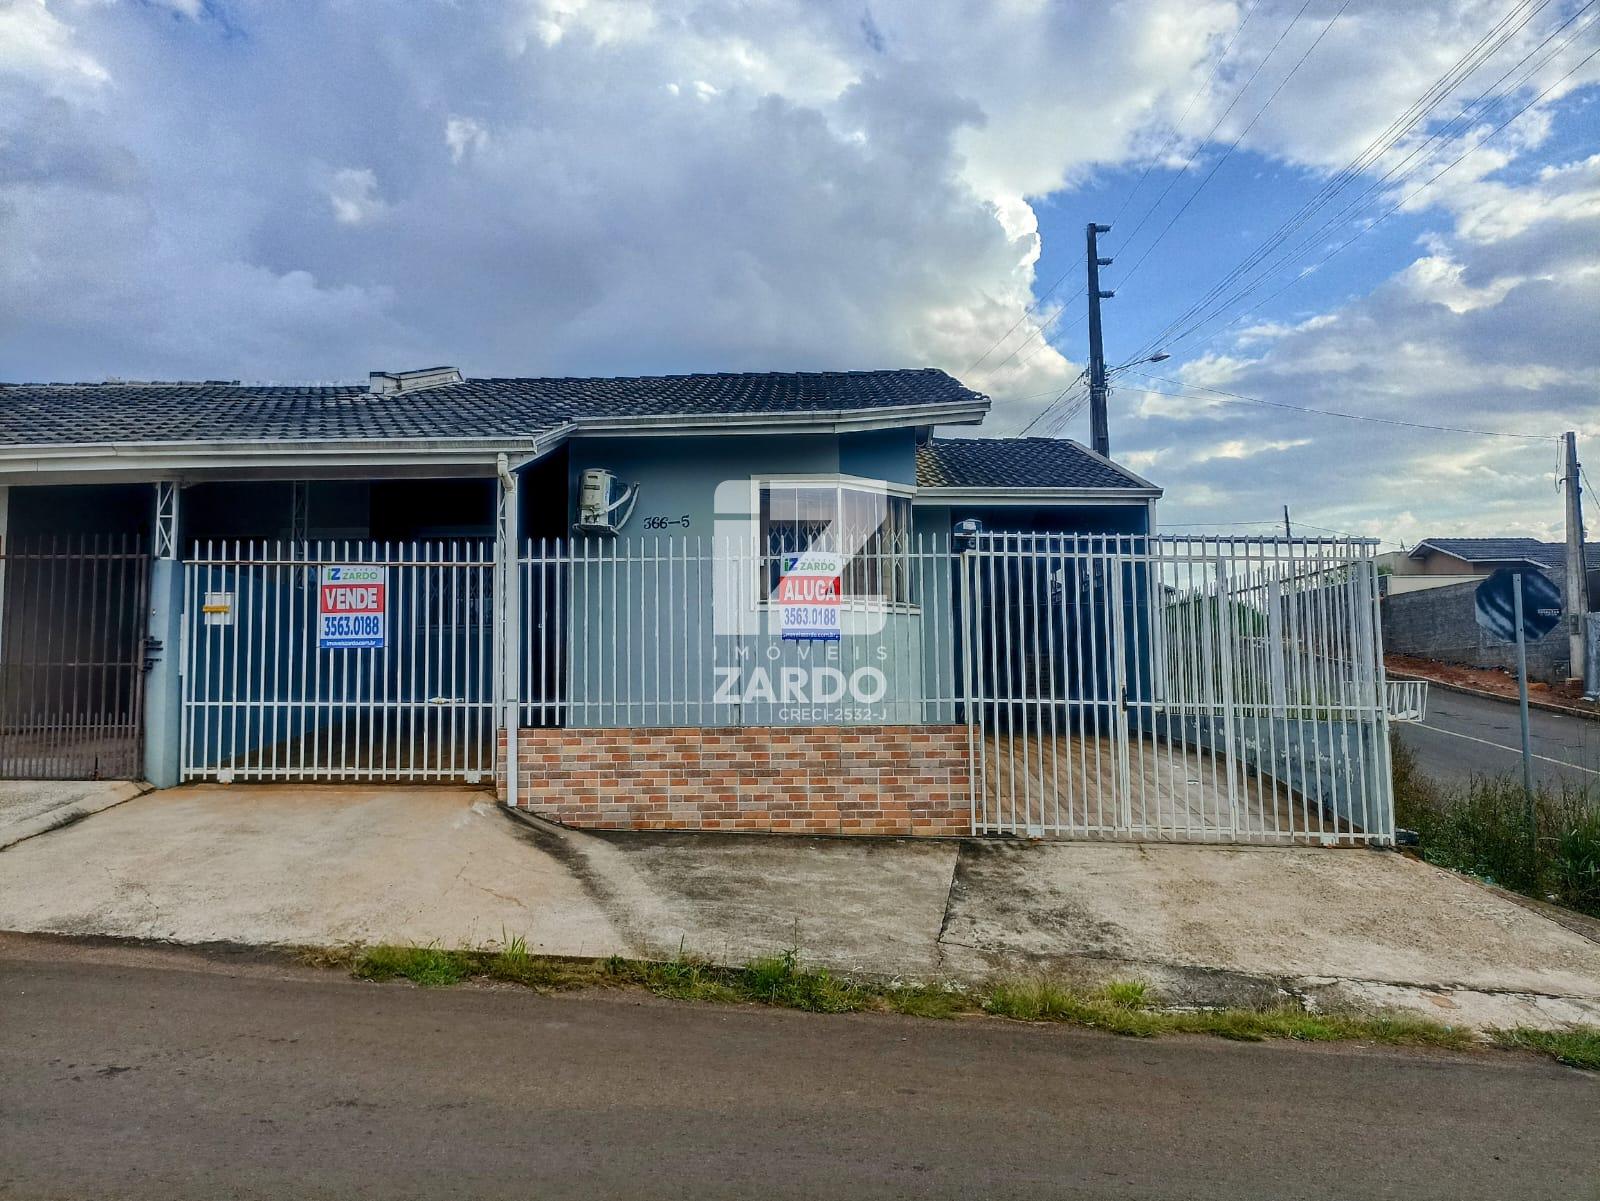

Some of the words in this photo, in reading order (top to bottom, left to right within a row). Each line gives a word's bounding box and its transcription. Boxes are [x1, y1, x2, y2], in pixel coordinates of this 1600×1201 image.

[643, 514, 690, 529] 366-5
[342, 571, 378, 580] ZARDO
[800, 562, 836, 571] ZARDO
[325, 588, 378, 610] VENDE
[784, 580, 836, 600] ALUGA
[784, 607, 836, 625] 3563.0188
[324, 615, 380, 636] 3563.0188
